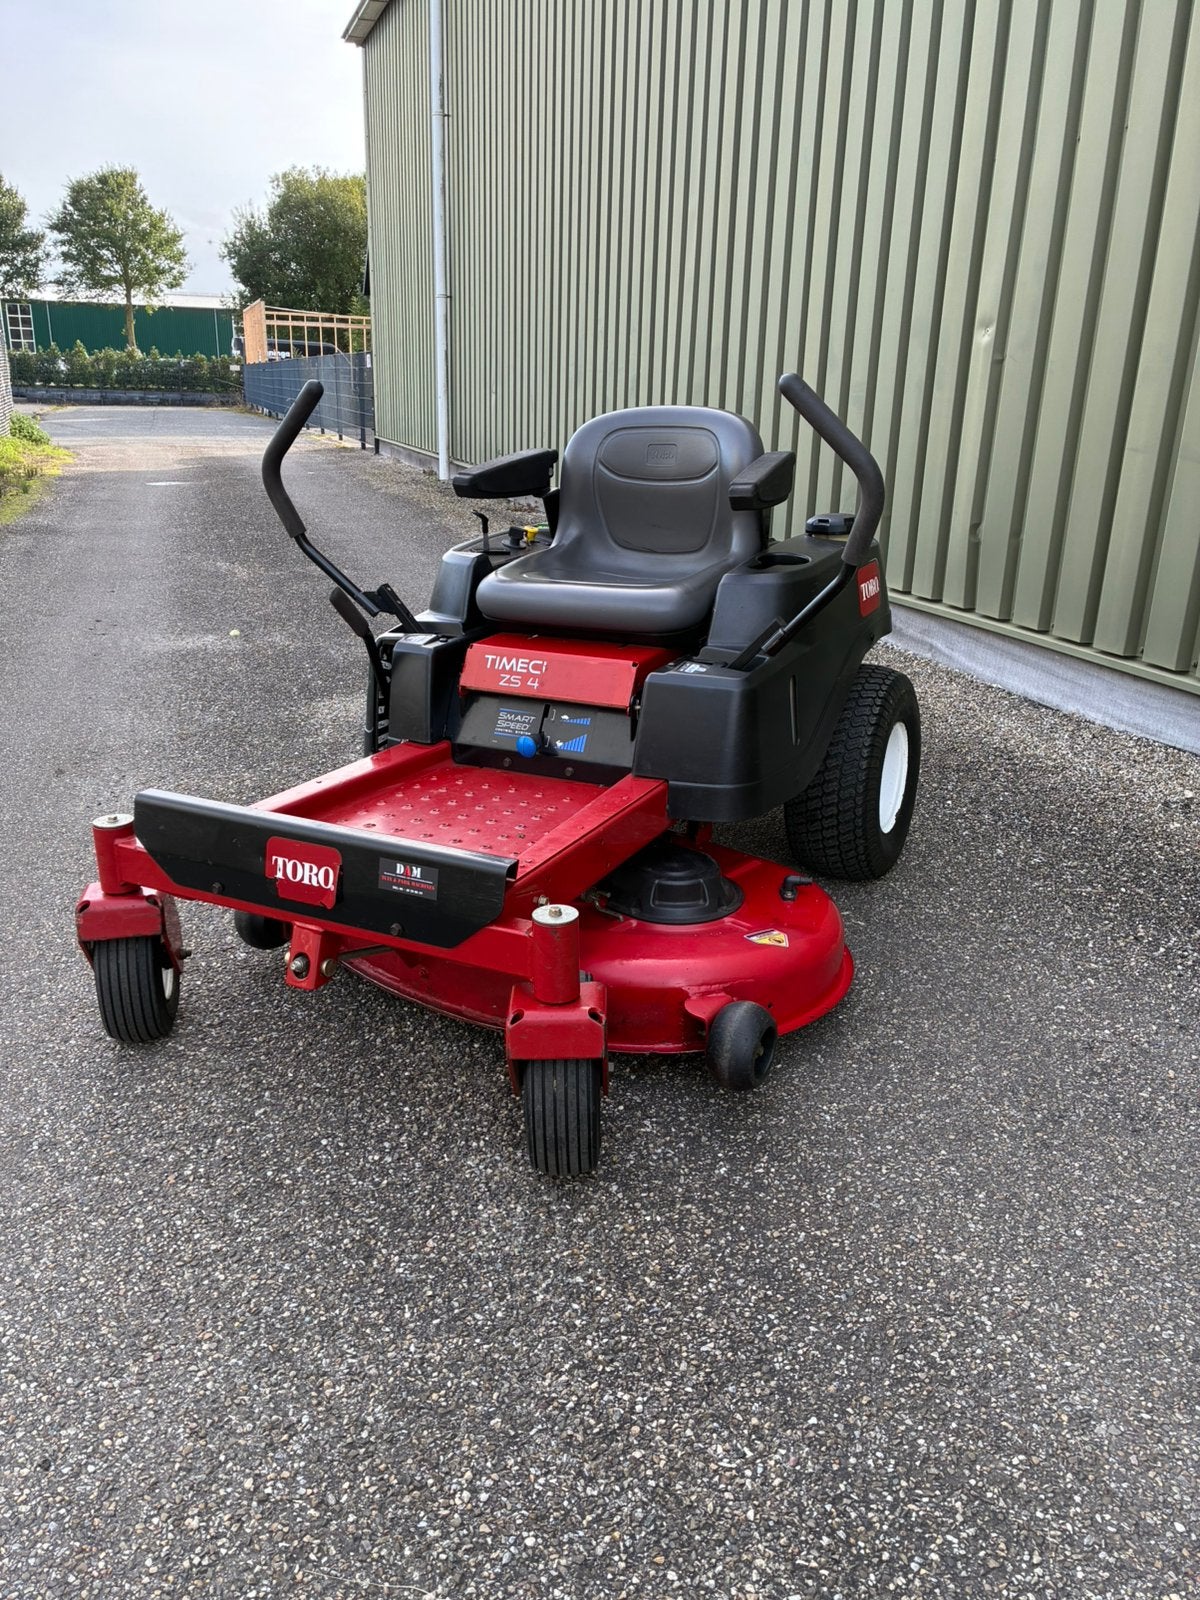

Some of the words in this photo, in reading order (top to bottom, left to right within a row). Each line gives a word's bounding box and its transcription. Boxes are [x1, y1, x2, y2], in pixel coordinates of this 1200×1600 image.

[860, 576, 880, 602] TORO
[499, 673, 522, 688] ZS
[527, 677, 540, 690] 4
[495, 720, 530, 731] SPEED
[498, 711, 536, 724] SMART
[271, 855, 335, 891] TORO
[396, 863, 422, 879] DAM
